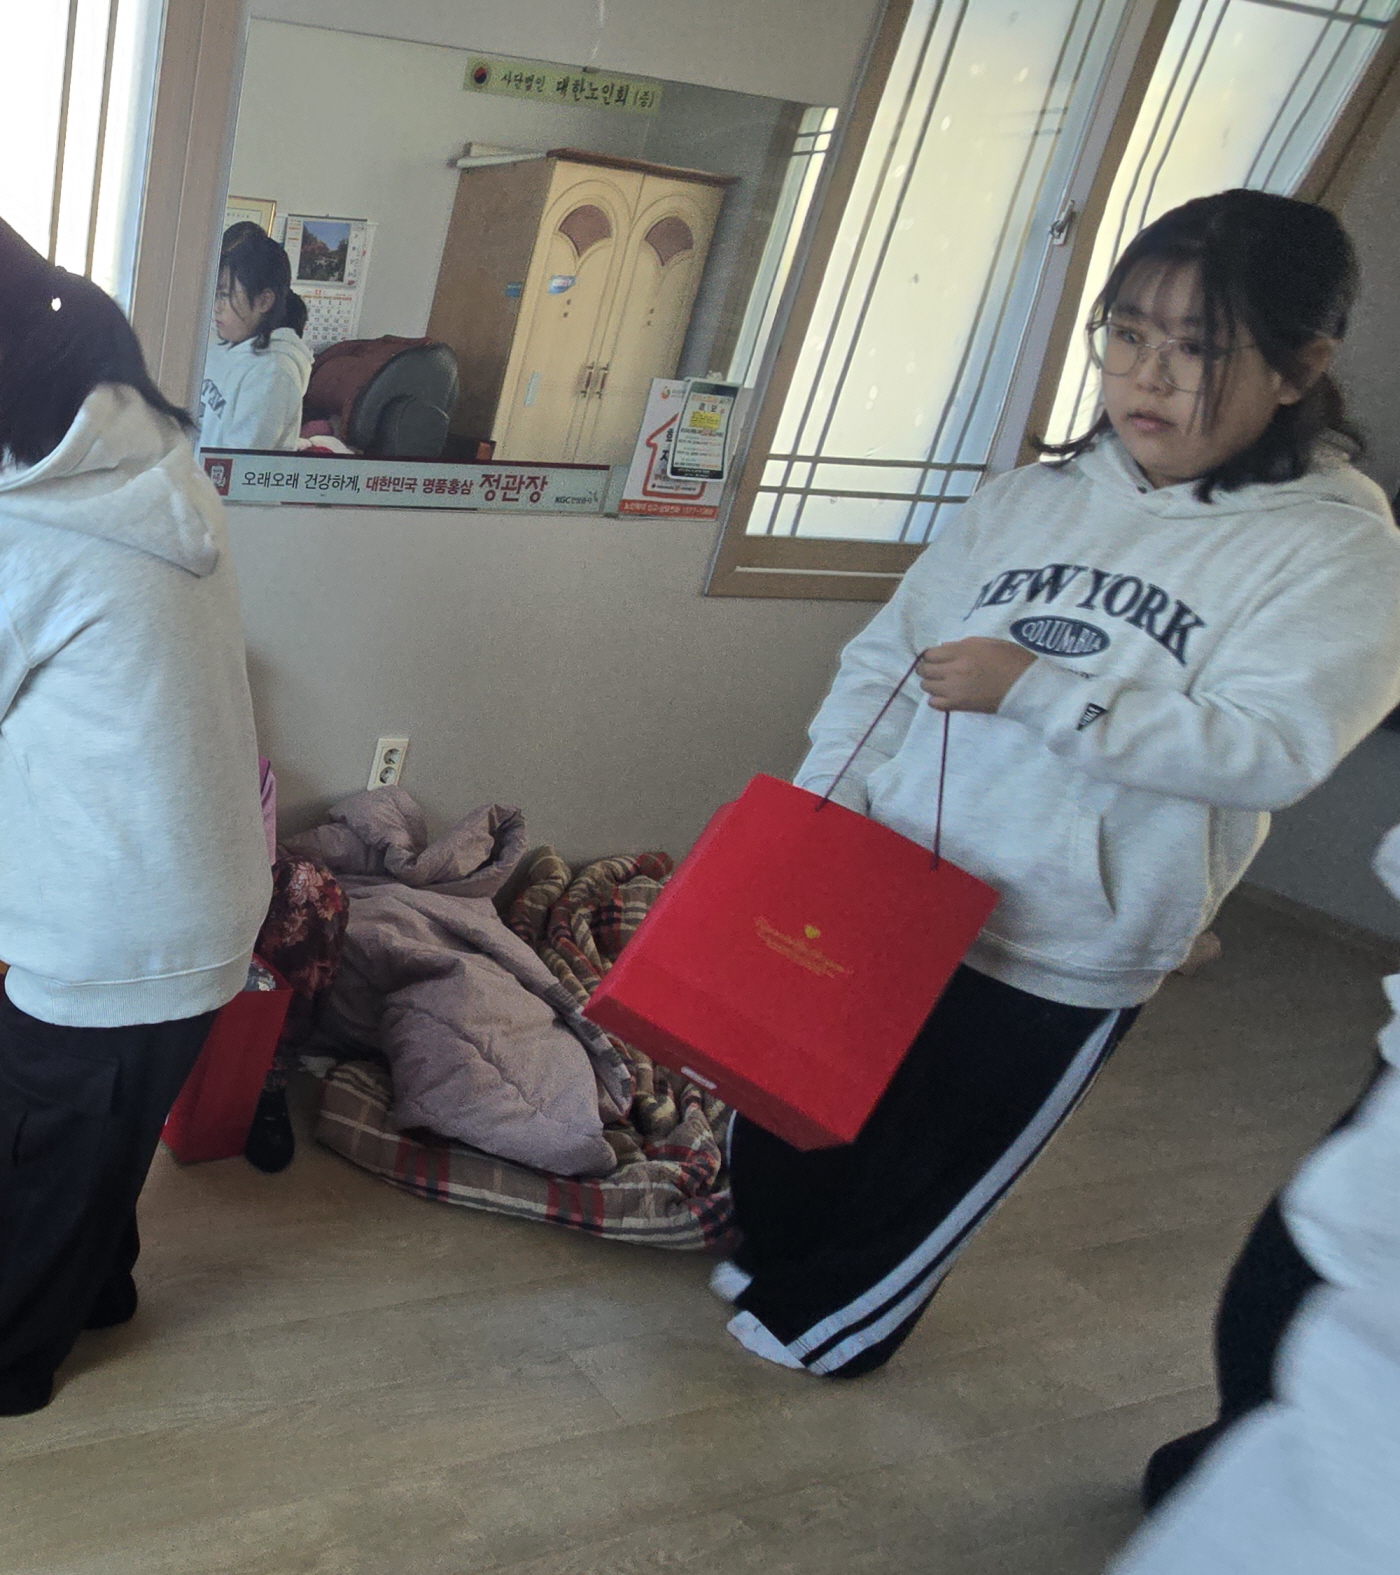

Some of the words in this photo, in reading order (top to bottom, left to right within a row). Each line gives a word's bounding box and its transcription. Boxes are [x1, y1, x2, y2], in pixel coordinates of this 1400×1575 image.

[500, 70, 546, 93] 사단법인
[556, 76, 630, 106] 대한노인회
[241, 471, 299, 489] 오래오래
[304, 474, 360, 493] 건강하게,
[365, 476, 418, 493] 대한민국
[422, 478, 473, 495] 명품홍삼
[479, 474, 548, 503] 정관장
[963, 564, 1089, 622] NEW
[1076, 568, 1207, 668] YORK
[1021, 620, 1103, 655] COLUMBIA
